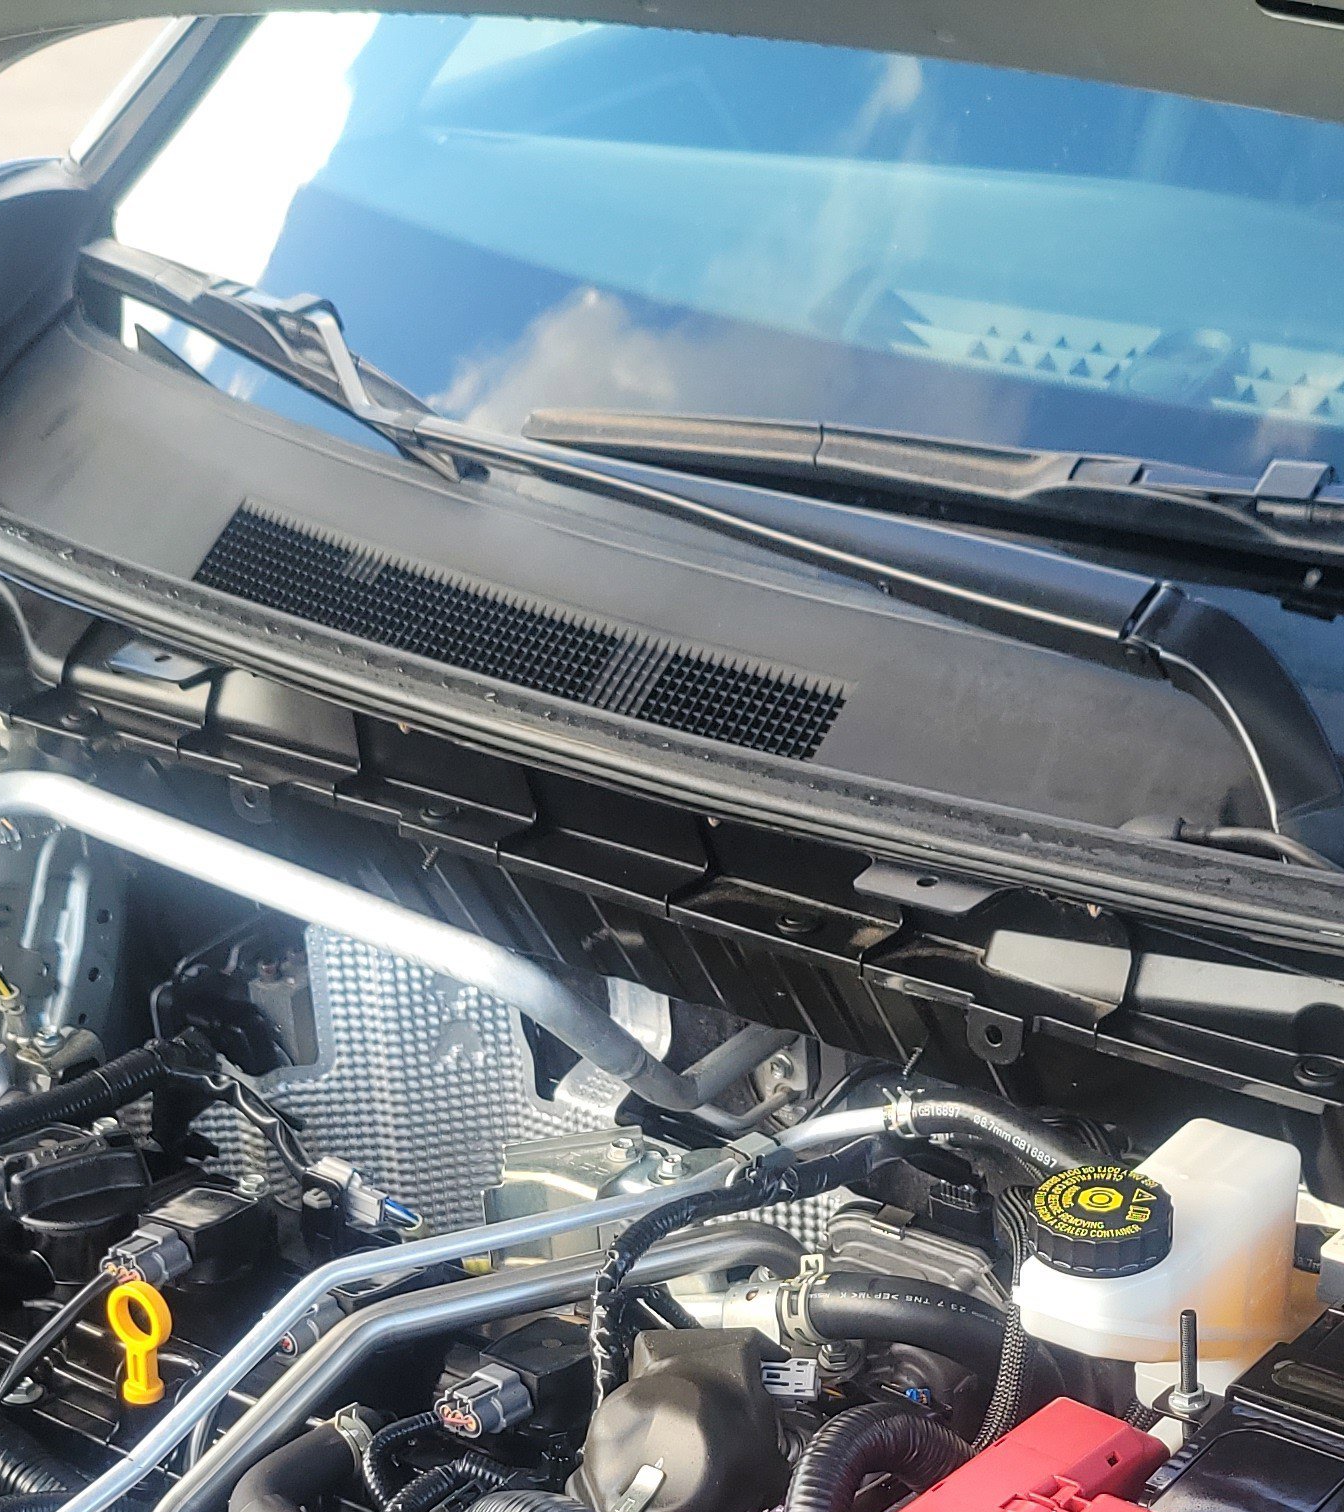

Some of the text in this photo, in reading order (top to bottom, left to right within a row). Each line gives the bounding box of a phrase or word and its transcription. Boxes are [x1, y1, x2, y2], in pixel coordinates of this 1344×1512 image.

[918, 1105, 961, 1118] GB16897
[1012, 1135, 1058, 1169] GB16897
[1081, 1165, 1095, 1174] OR
[1090, 1171, 1125, 1182] CLEAN
[1058, 1212, 1105, 1229] REMOVING
[1056, 1222, 1089, 1236] SEALED
[1089, 1224, 1142, 1238] CONTAINER
